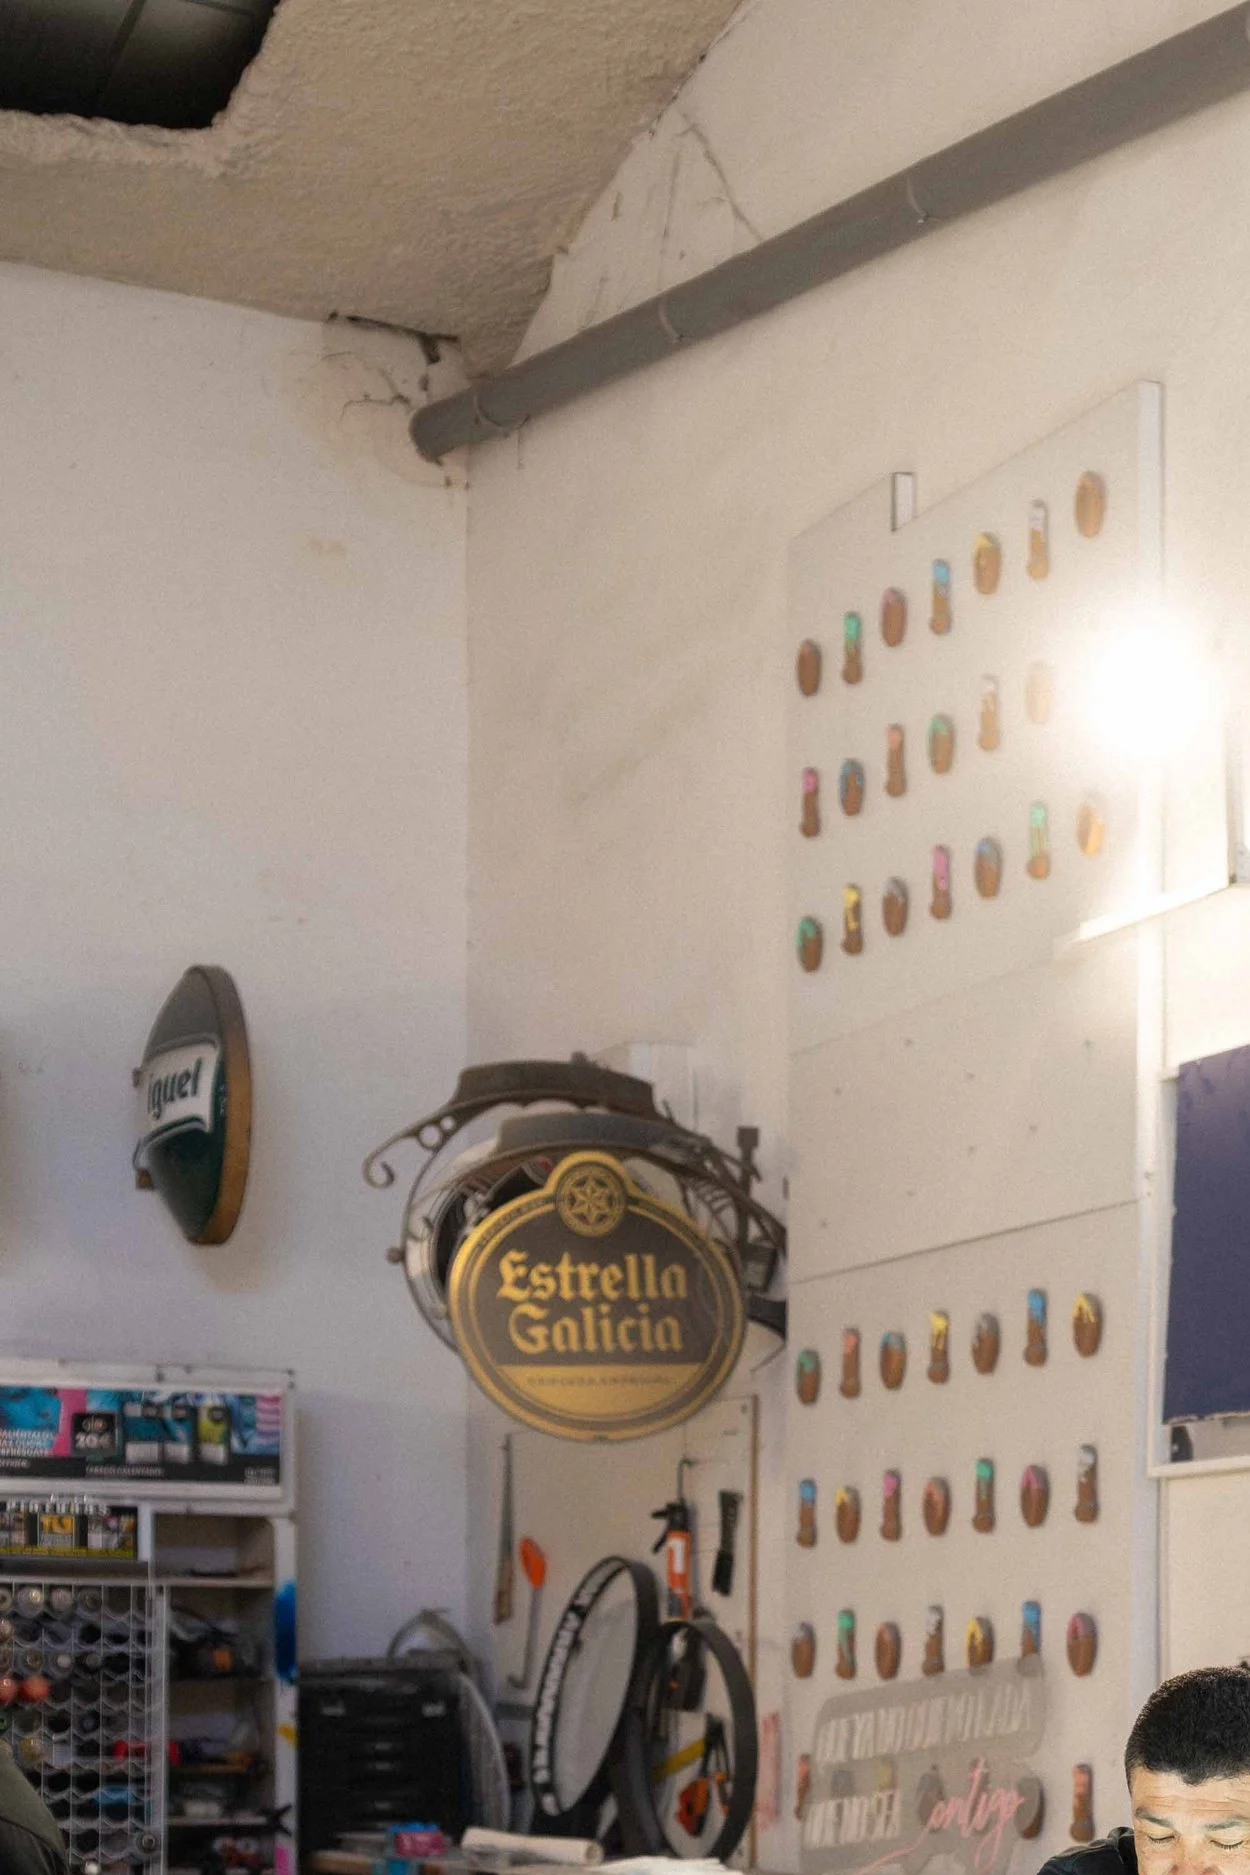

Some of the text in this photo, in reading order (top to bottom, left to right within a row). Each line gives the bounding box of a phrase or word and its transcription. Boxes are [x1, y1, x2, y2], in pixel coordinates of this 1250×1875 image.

[148, 1056, 203, 1120] iguel
[496, 1249, 688, 1301] Estrella
[508, 1302, 685, 1354] Galicia
